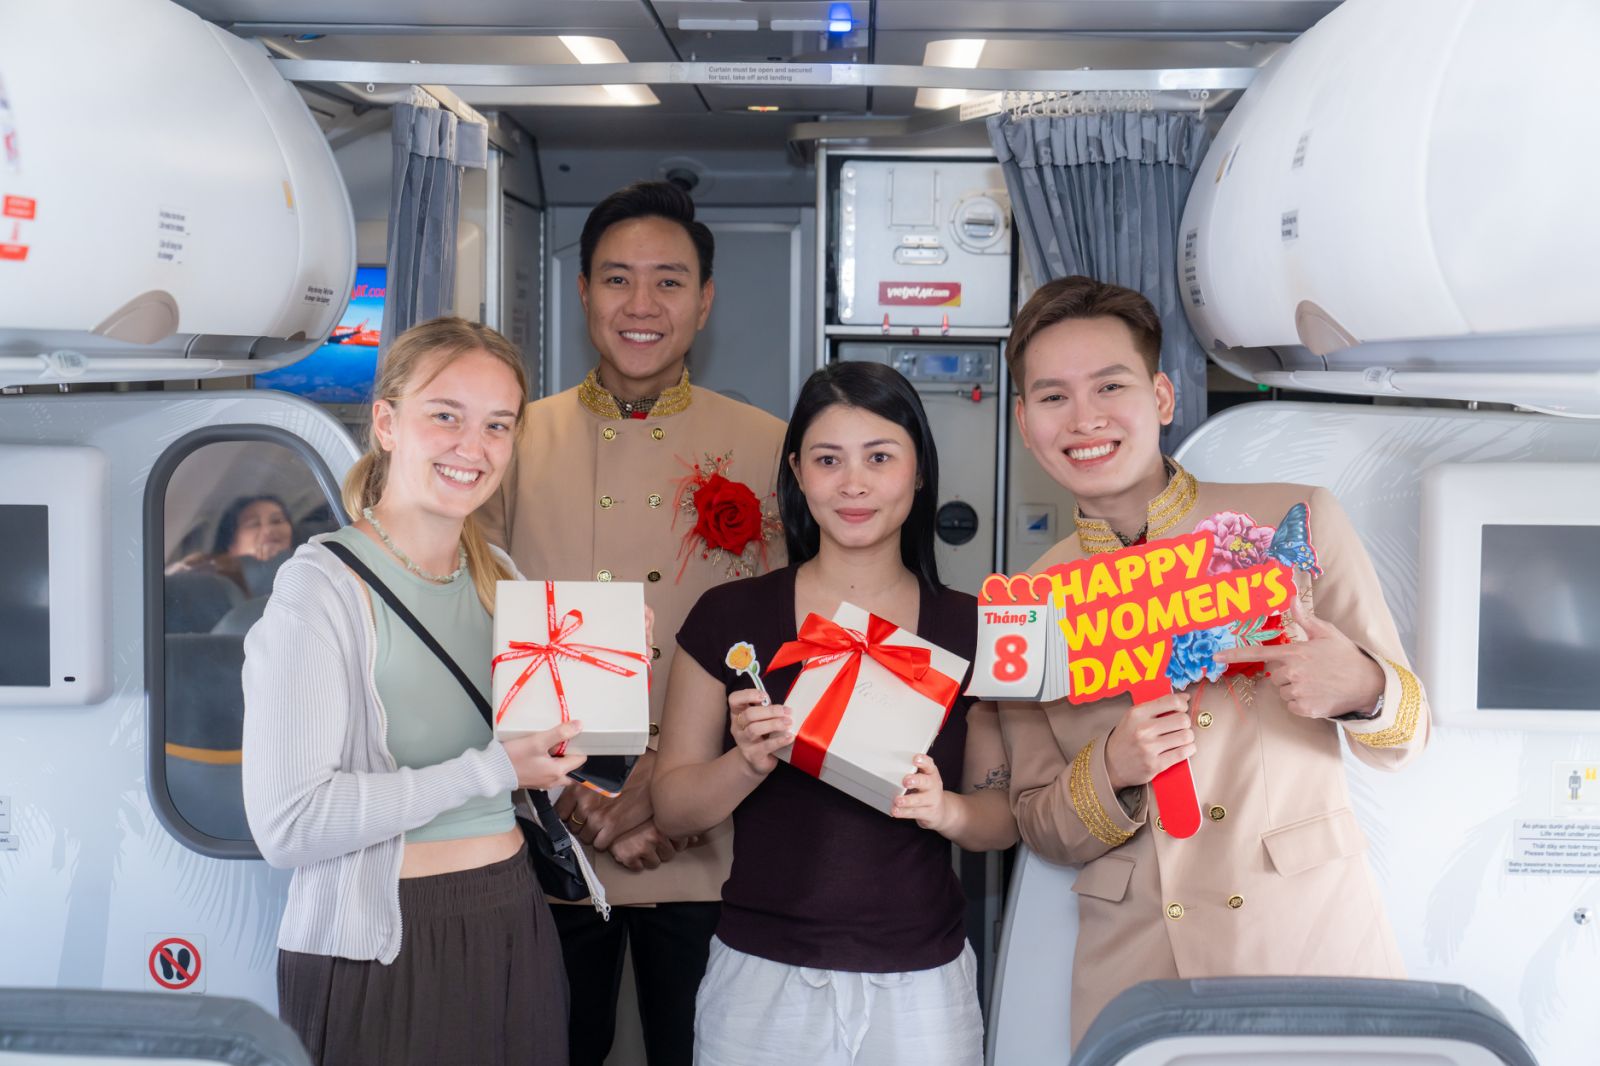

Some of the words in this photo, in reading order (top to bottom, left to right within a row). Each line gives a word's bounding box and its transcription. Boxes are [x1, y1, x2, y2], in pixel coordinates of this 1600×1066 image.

[758, 67, 774, 75] open
[1050, 538, 1207, 609] HAPPY
[1057, 567, 1288, 651] WOMEN'S
[992, 634, 1028, 683] 8
[1069, 641, 1166, 697] DAY
